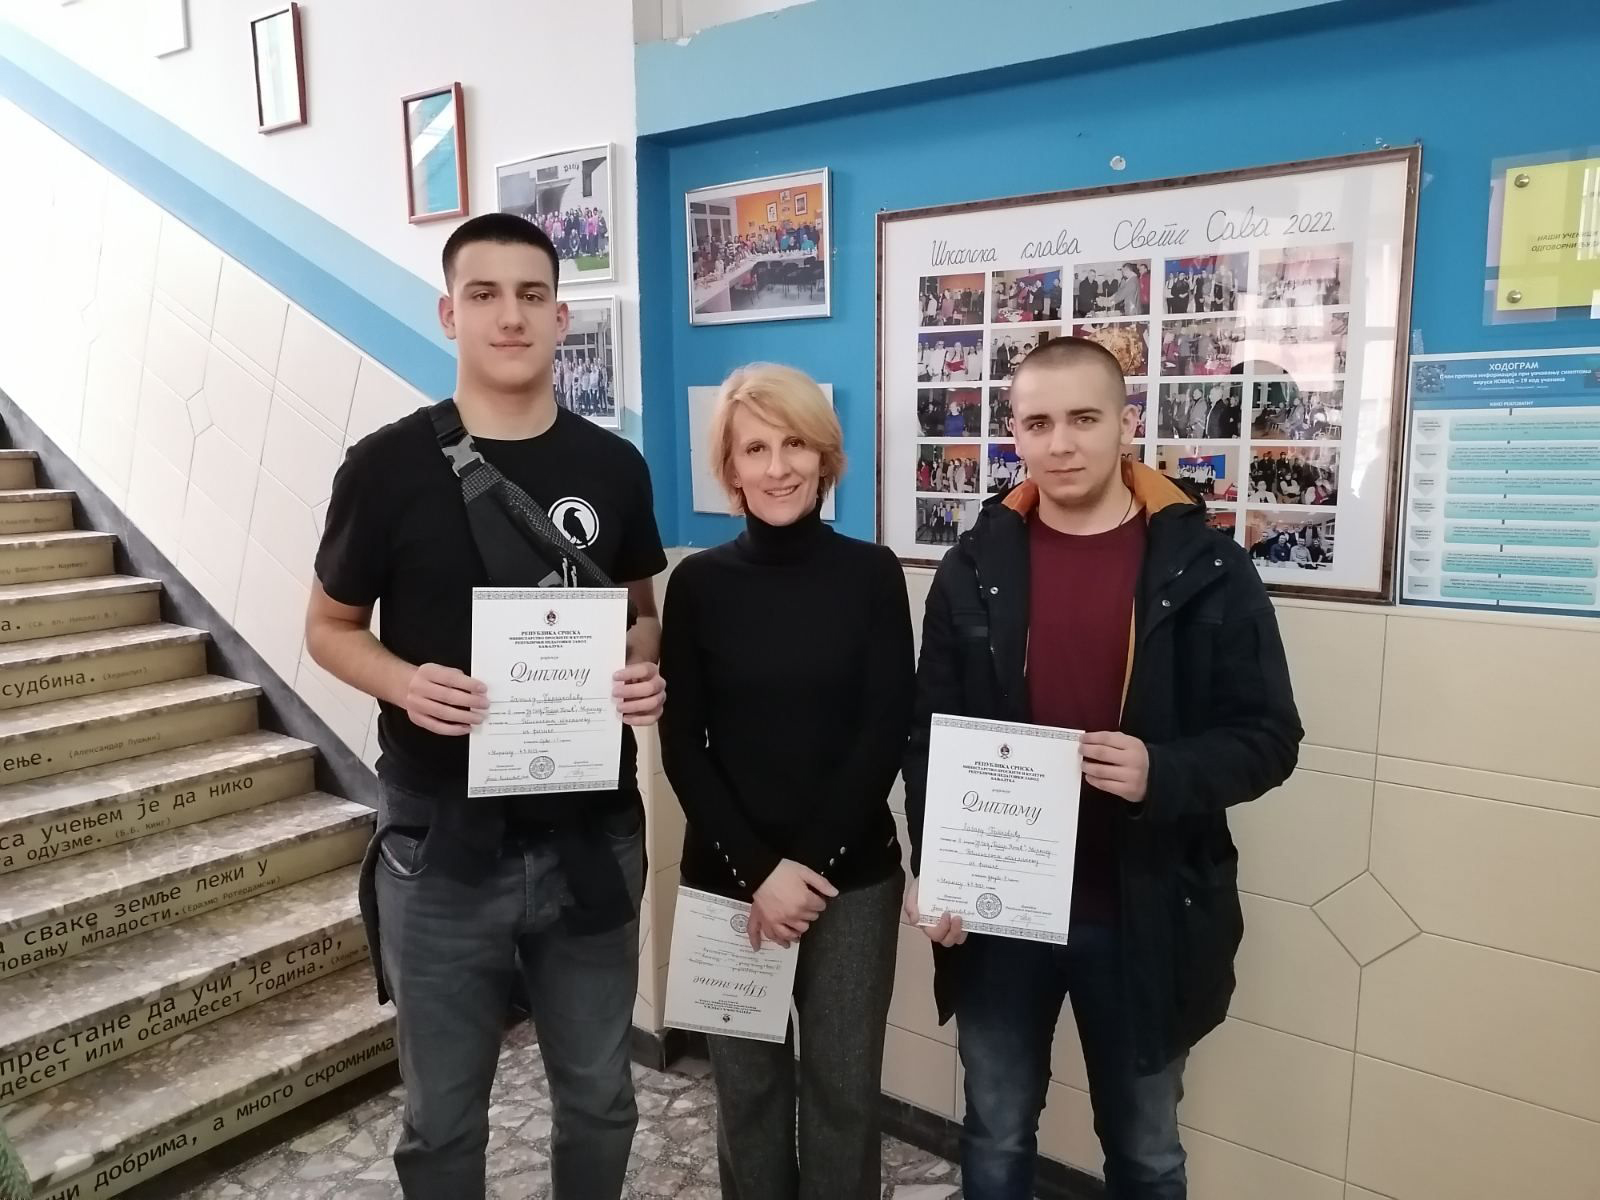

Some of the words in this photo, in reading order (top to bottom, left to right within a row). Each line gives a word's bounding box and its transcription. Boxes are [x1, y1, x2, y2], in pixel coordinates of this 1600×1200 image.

[931, 239, 998, 267] Школска
[1021, 229, 1082, 259] слава
[1113, 217, 1190, 250] Свети
[1206, 206, 1269, 243] Сава
[1283, 211, 1335, 235] 2022.
[1489, 361, 1539, 372] ХОДОГРАМ
[2, 671, 96, 698] судбина.
[510, 661, 591, 688] Диплому
[41, 808, 123, 845] учењем
[137, 799, 160, 820] је
[173, 791, 196, 810] да
[209, 776, 254, 798] нико
[962, 790, 1042, 826] Диплому
[27, 834, 102, 862] одузме.
[24, 912, 98, 946] сваке
[114, 886, 181, 918] земље
[196, 866, 244, 893] лежи
[257, 858, 268, 877] у
[81, 908, 180, 946] младости.
[1, 1012, 132, 1076] престане
[148, 996, 176, 1022] да
[191, 973, 233, 1001] учи
[248, 960, 272, 985] је
[286, 937, 342, 965] стар,
[1, 1058, 71, 1100] десет
[85, 1037, 124, 1064] или
[137, 990, 243, 1042] осамдесет
[255, 960, 324, 996] година.
[94, 1133, 198, 1192] добрима,
[212, 1115, 225, 1132] а
[236, 1084, 294, 1121] много
[304, 1036, 394, 1089] скромнима
